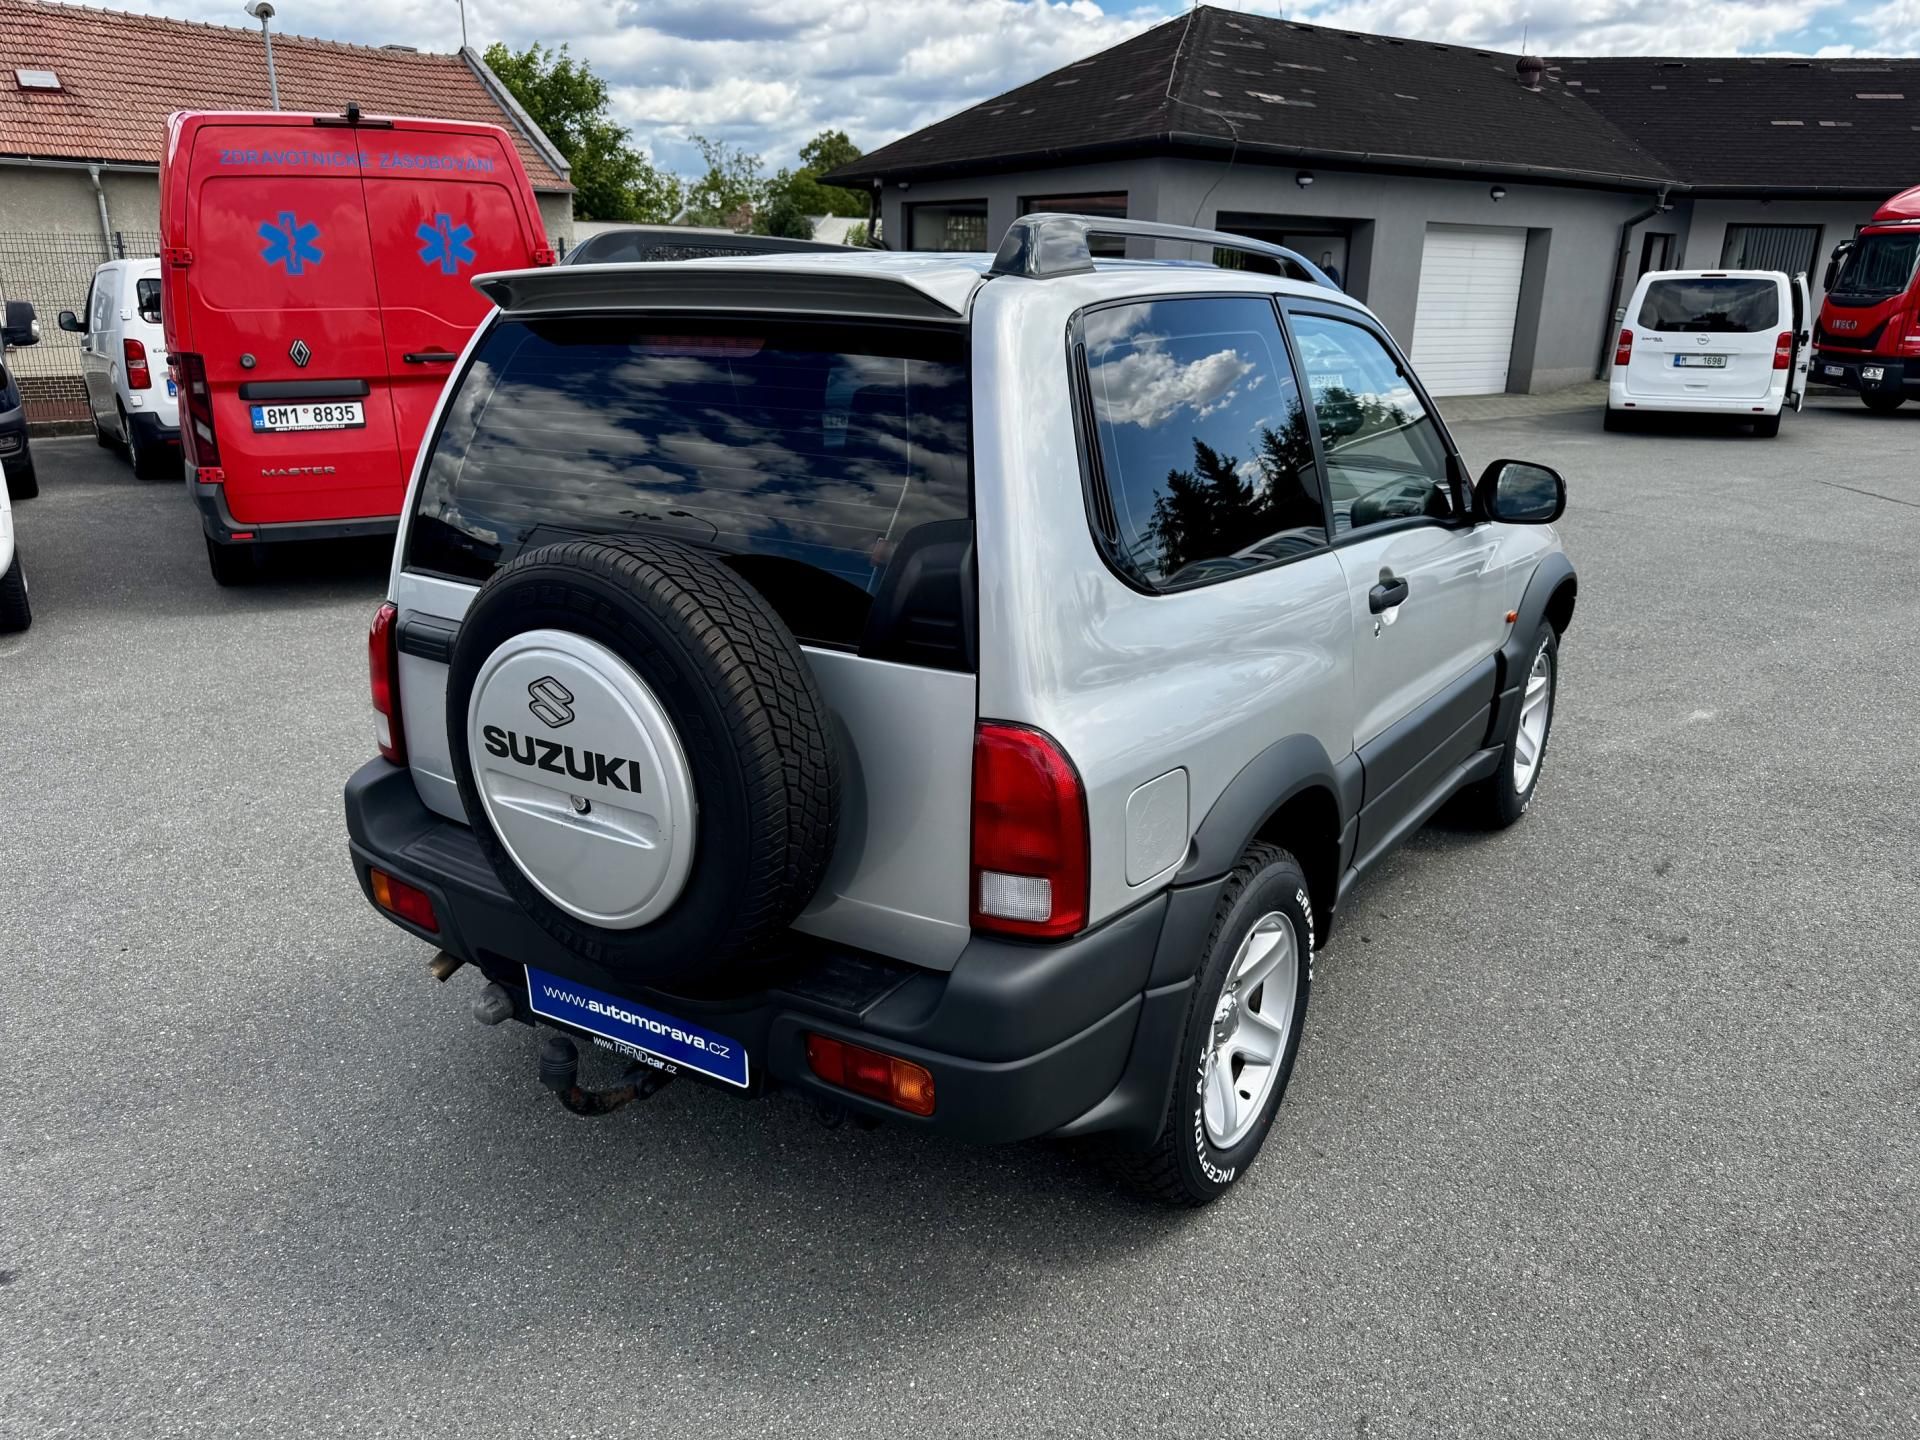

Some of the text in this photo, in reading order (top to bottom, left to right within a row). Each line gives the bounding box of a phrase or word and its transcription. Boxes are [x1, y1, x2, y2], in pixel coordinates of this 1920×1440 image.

[1702, 356, 1723, 366] 1698
[267, 405, 355, 426] 8M1 8835
[261, 465, 337, 477] MASTER
[483, 724, 643, 795] SUZUKI
[1295, 888, 1314, 929] GRIP
[542, 984, 732, 1060] www.automorava.cz
[1193, 1107, 1236, 1185] INCEPTION
